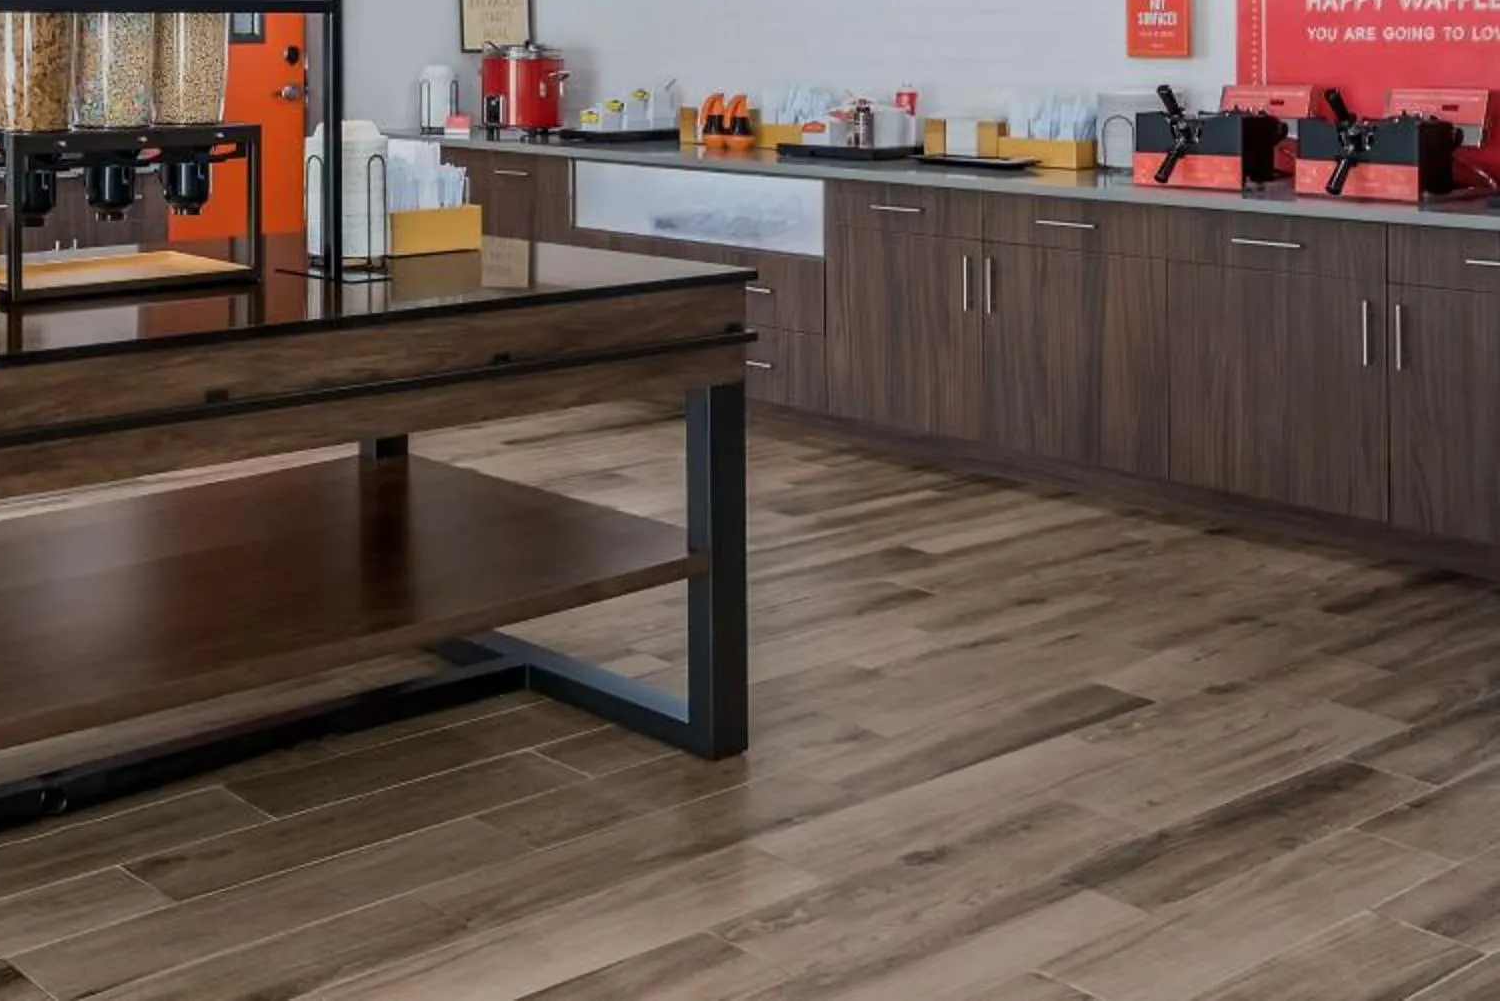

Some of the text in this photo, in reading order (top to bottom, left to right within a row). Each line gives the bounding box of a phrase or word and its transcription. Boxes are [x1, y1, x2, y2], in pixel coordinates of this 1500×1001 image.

[1307, 26, 1338, 41] YOU
[1344, 27, 1376, 40] ARE
[1383, 26, 1435, 41] GOING
[1443, 25, 1465, 40] TO
